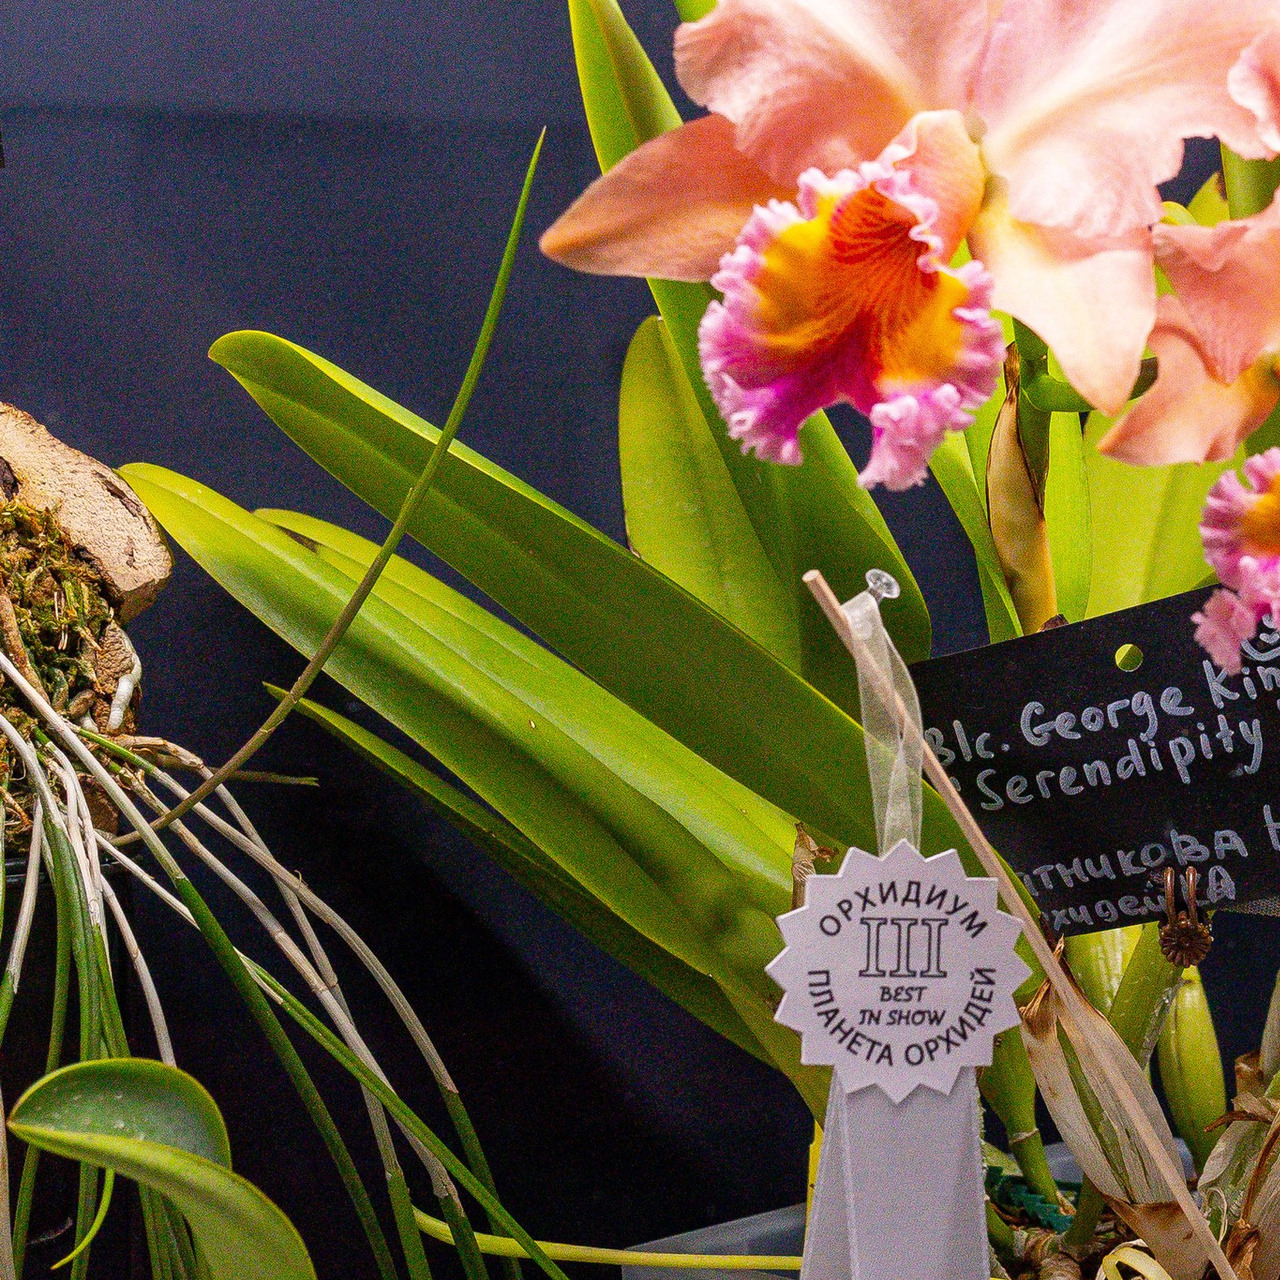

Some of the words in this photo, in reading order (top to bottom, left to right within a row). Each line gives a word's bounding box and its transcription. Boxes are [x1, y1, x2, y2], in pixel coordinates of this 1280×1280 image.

[1020, 686, 1195, 747] George
[819, 880, 988, 938] ОРХИДИУМ
[859, 917, 949, 978] III
[807, 970, 894, 1067] ПЛАНЕТА
[904, 967, 997, 1067] ОРХИДЕЙ
[879, 986, 928, 1003] BEST
[886, 1009, 947, 1027] SHOW
